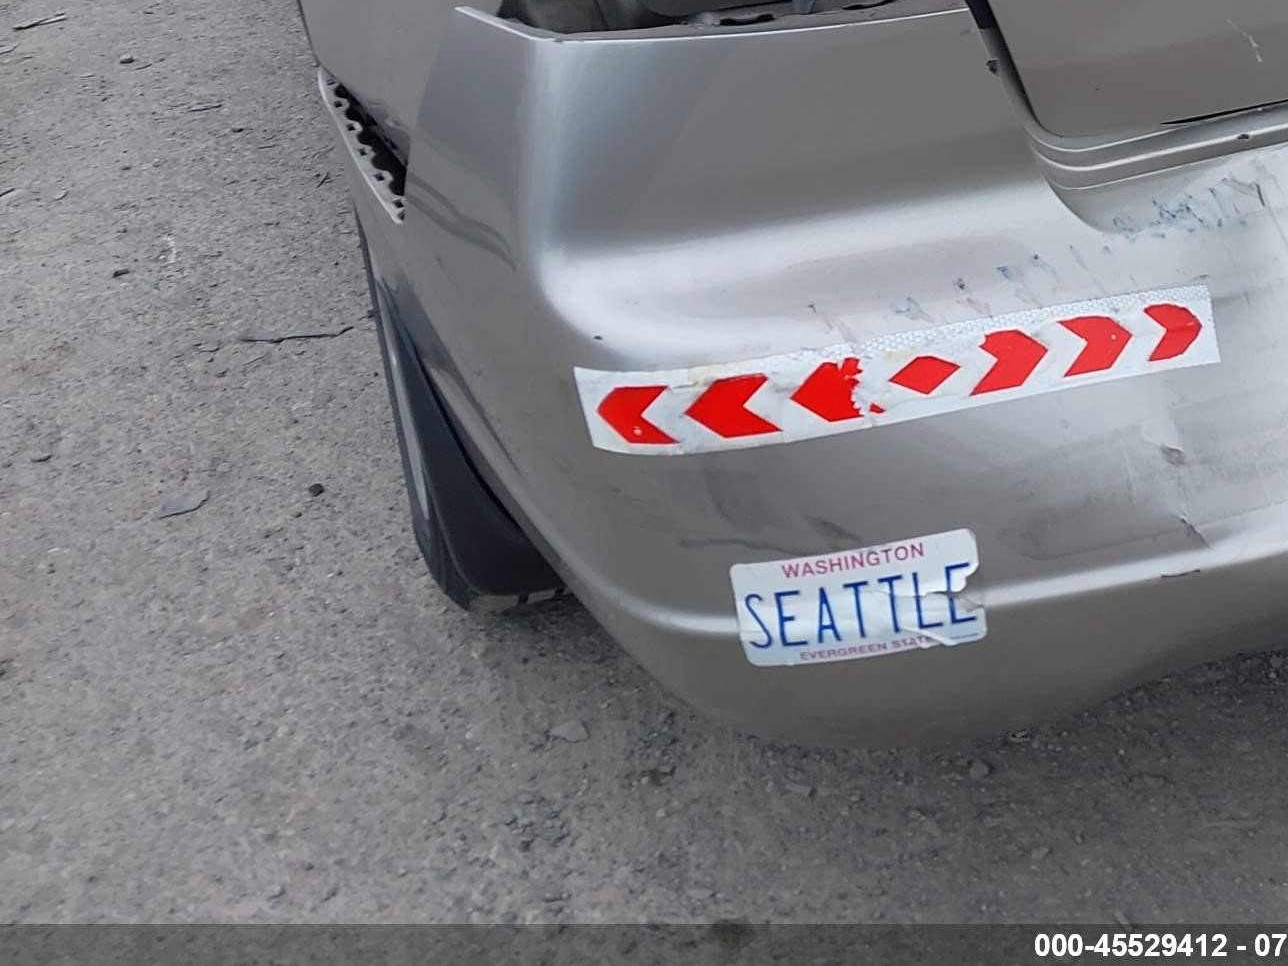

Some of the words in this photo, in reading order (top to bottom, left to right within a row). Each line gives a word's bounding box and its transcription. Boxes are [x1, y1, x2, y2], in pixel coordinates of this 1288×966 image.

[781, 541, 924, 580] WASHINGTON
[744, 561, 977, 649] SEATTLE
[800, 642, 887, 661] EVERGREEN
